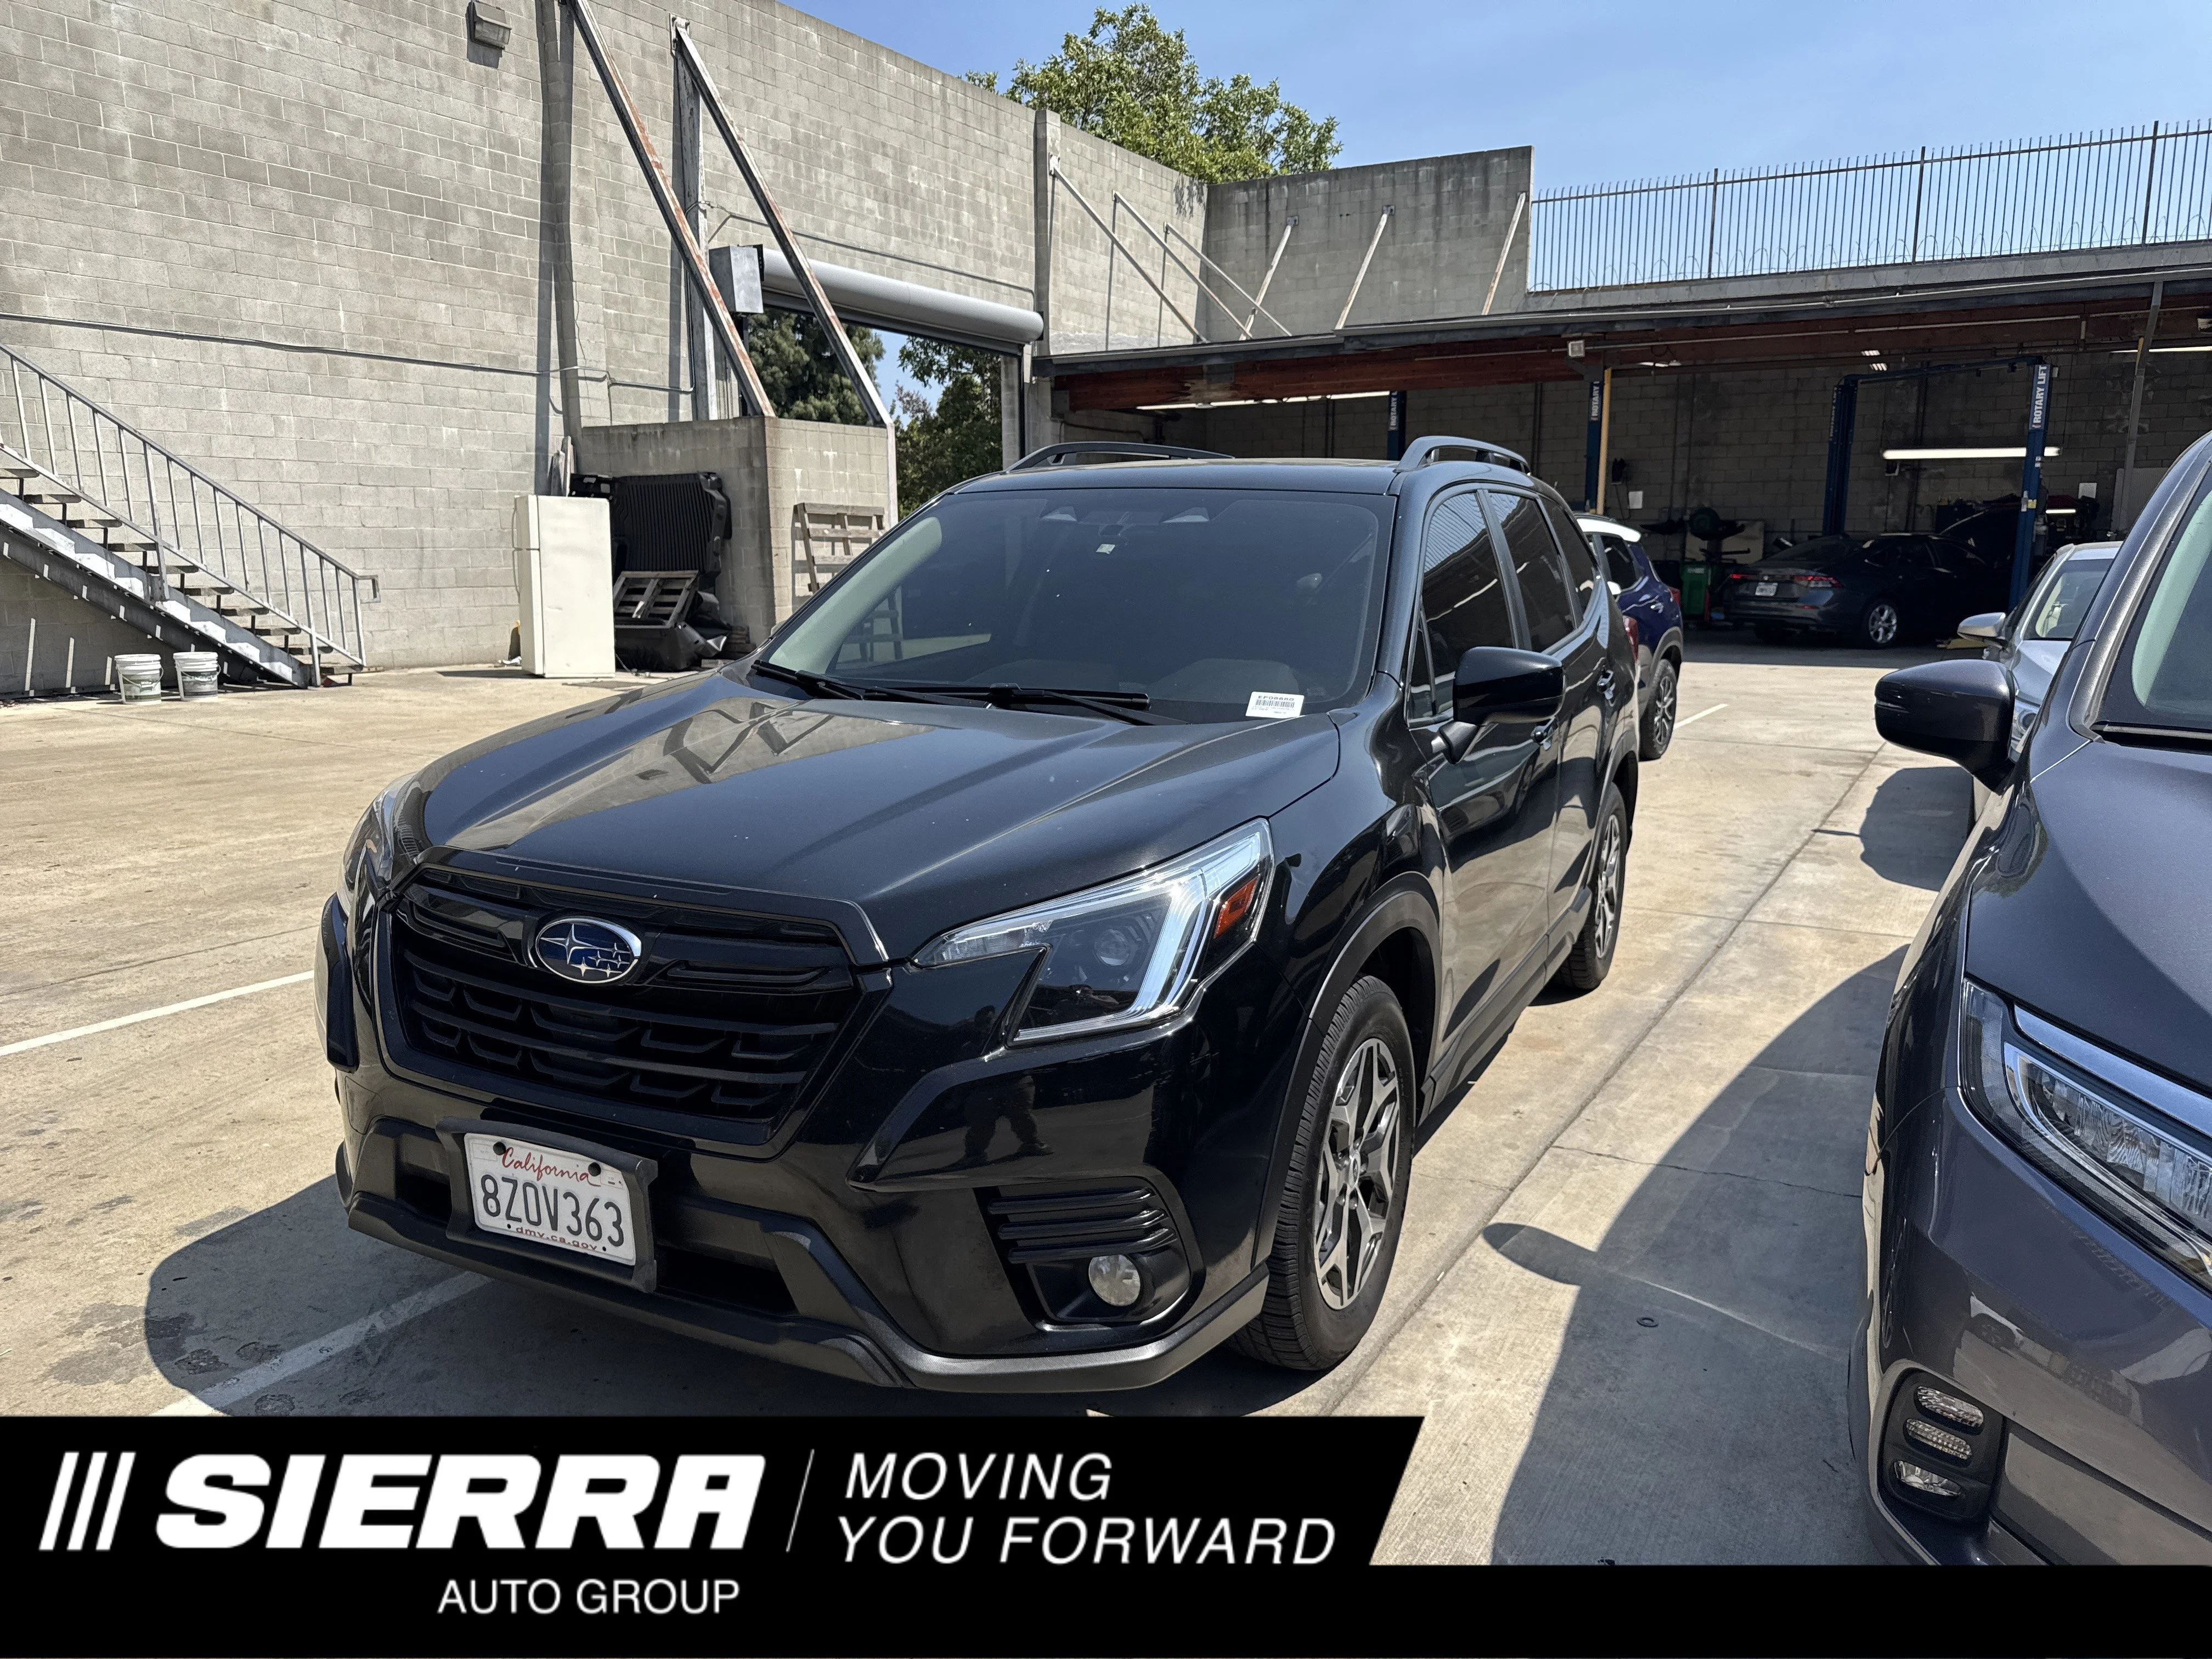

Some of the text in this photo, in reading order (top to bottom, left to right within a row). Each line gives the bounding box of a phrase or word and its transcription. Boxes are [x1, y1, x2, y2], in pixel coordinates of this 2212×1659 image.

[2033, 365, 2047, 424] ROTARY LIFT
[501, 1147, 601, 1187] California
[516, 1226, 597, 1251] dmv.ca.gov
